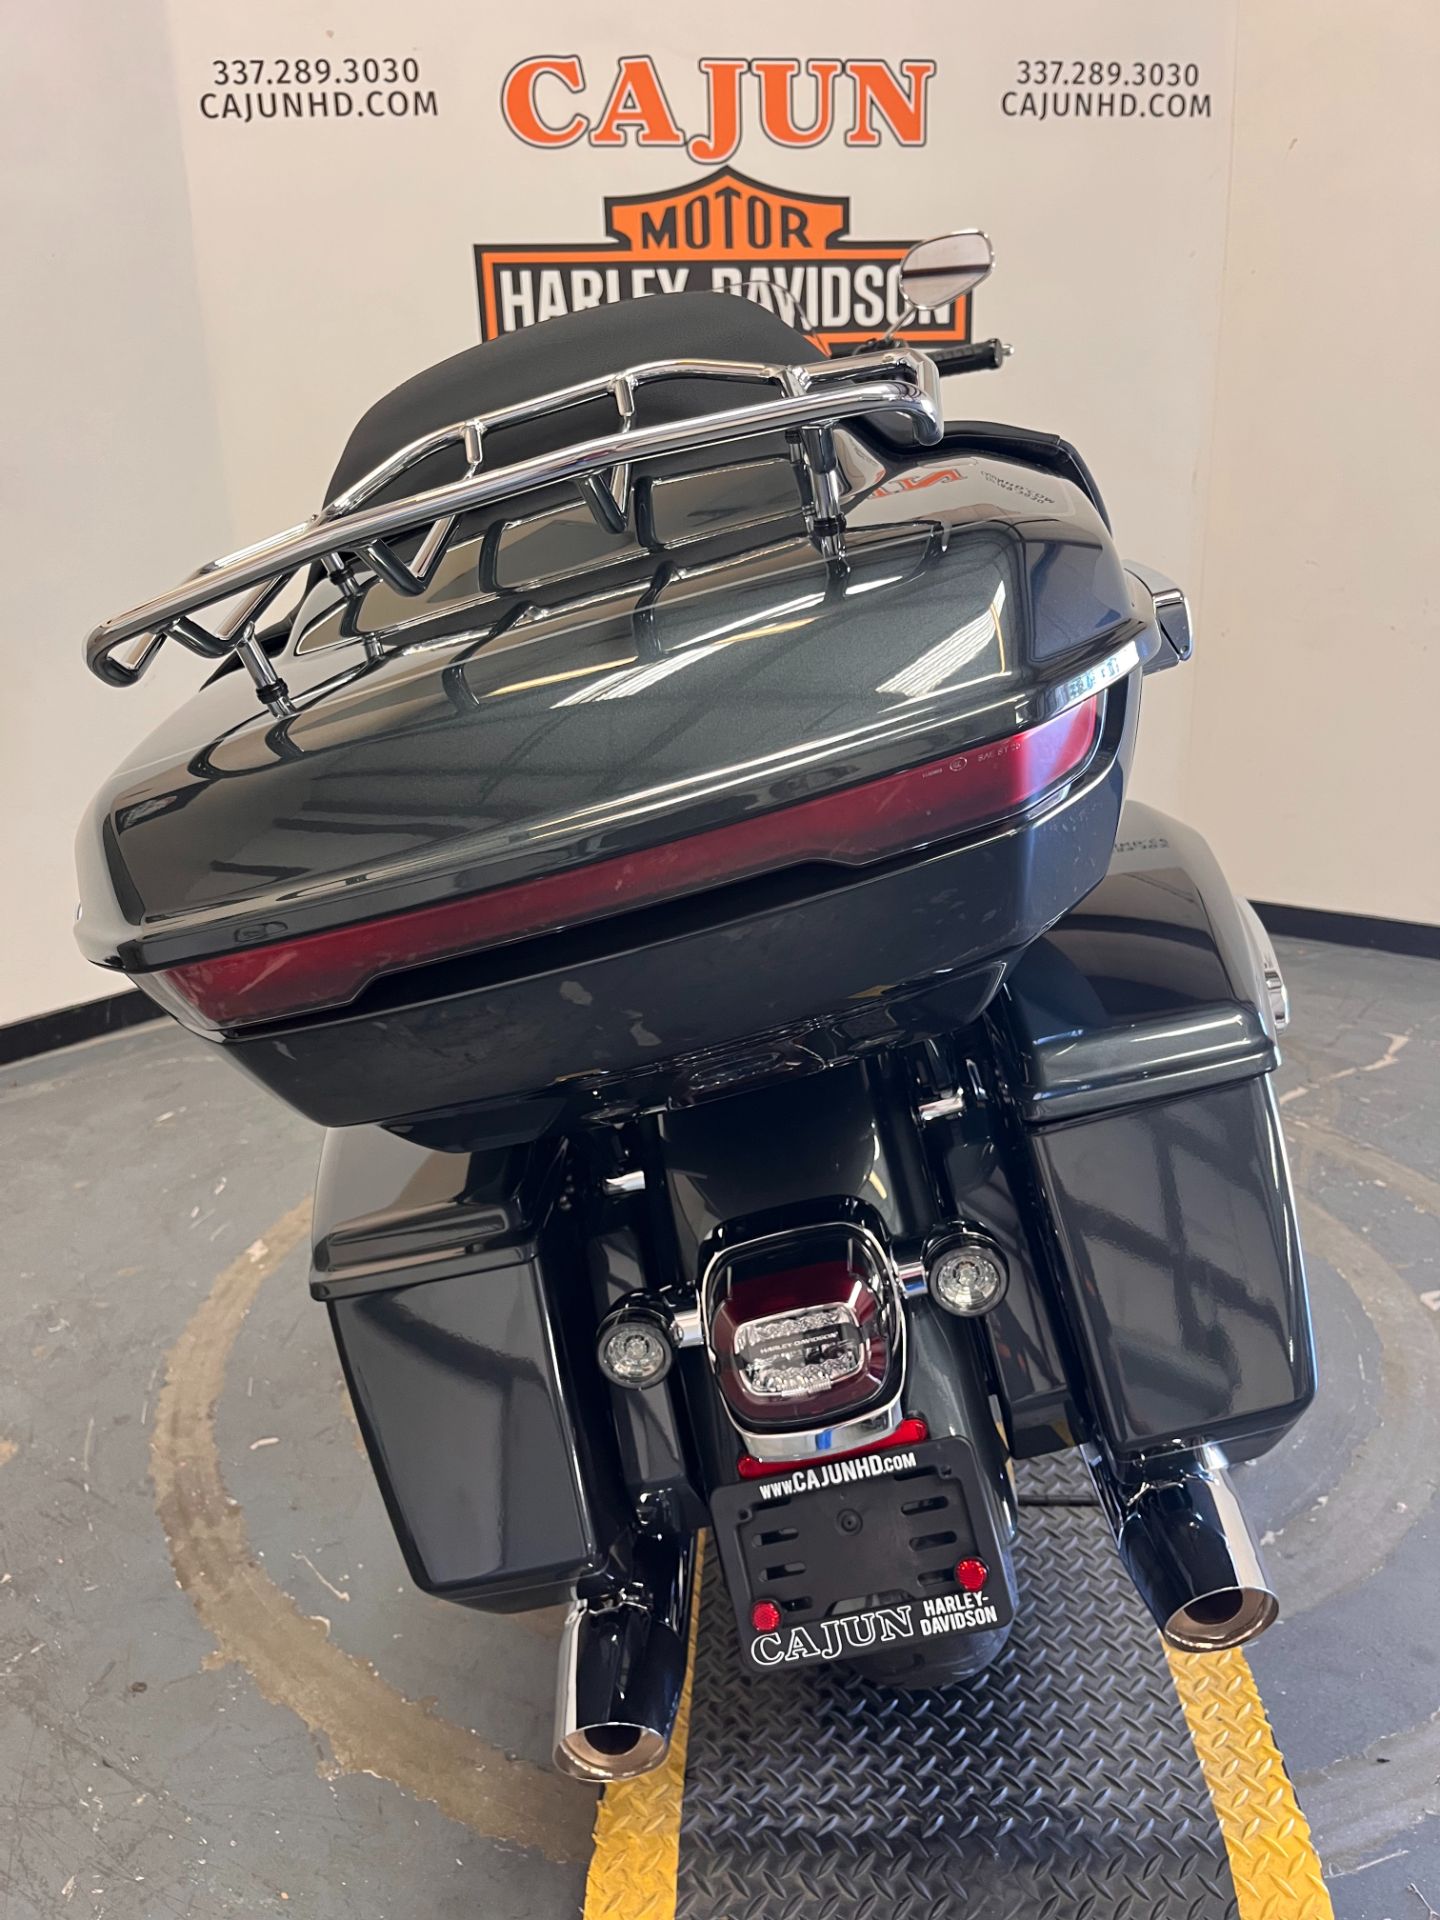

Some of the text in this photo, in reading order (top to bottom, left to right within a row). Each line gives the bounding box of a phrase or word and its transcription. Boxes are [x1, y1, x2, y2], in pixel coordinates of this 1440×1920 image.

[212, 57, 420, 86] 337.289.3030
[1016, 60, 1200, 87] 337.289.3030
[200, 90, 439, 123] CAJUNHD.COM
[501, 54, 937, 165] CAJUN
[1001, 91, 1212, 121] CAJUNHD.COM
[641, 186, 811, 250] MOTOR
[922, 1591, 989, 1617] HARLEY-
[751, 1605, 914, 1666] CAJUN
[919, 1606, 998, 1637] DAVIDSON
